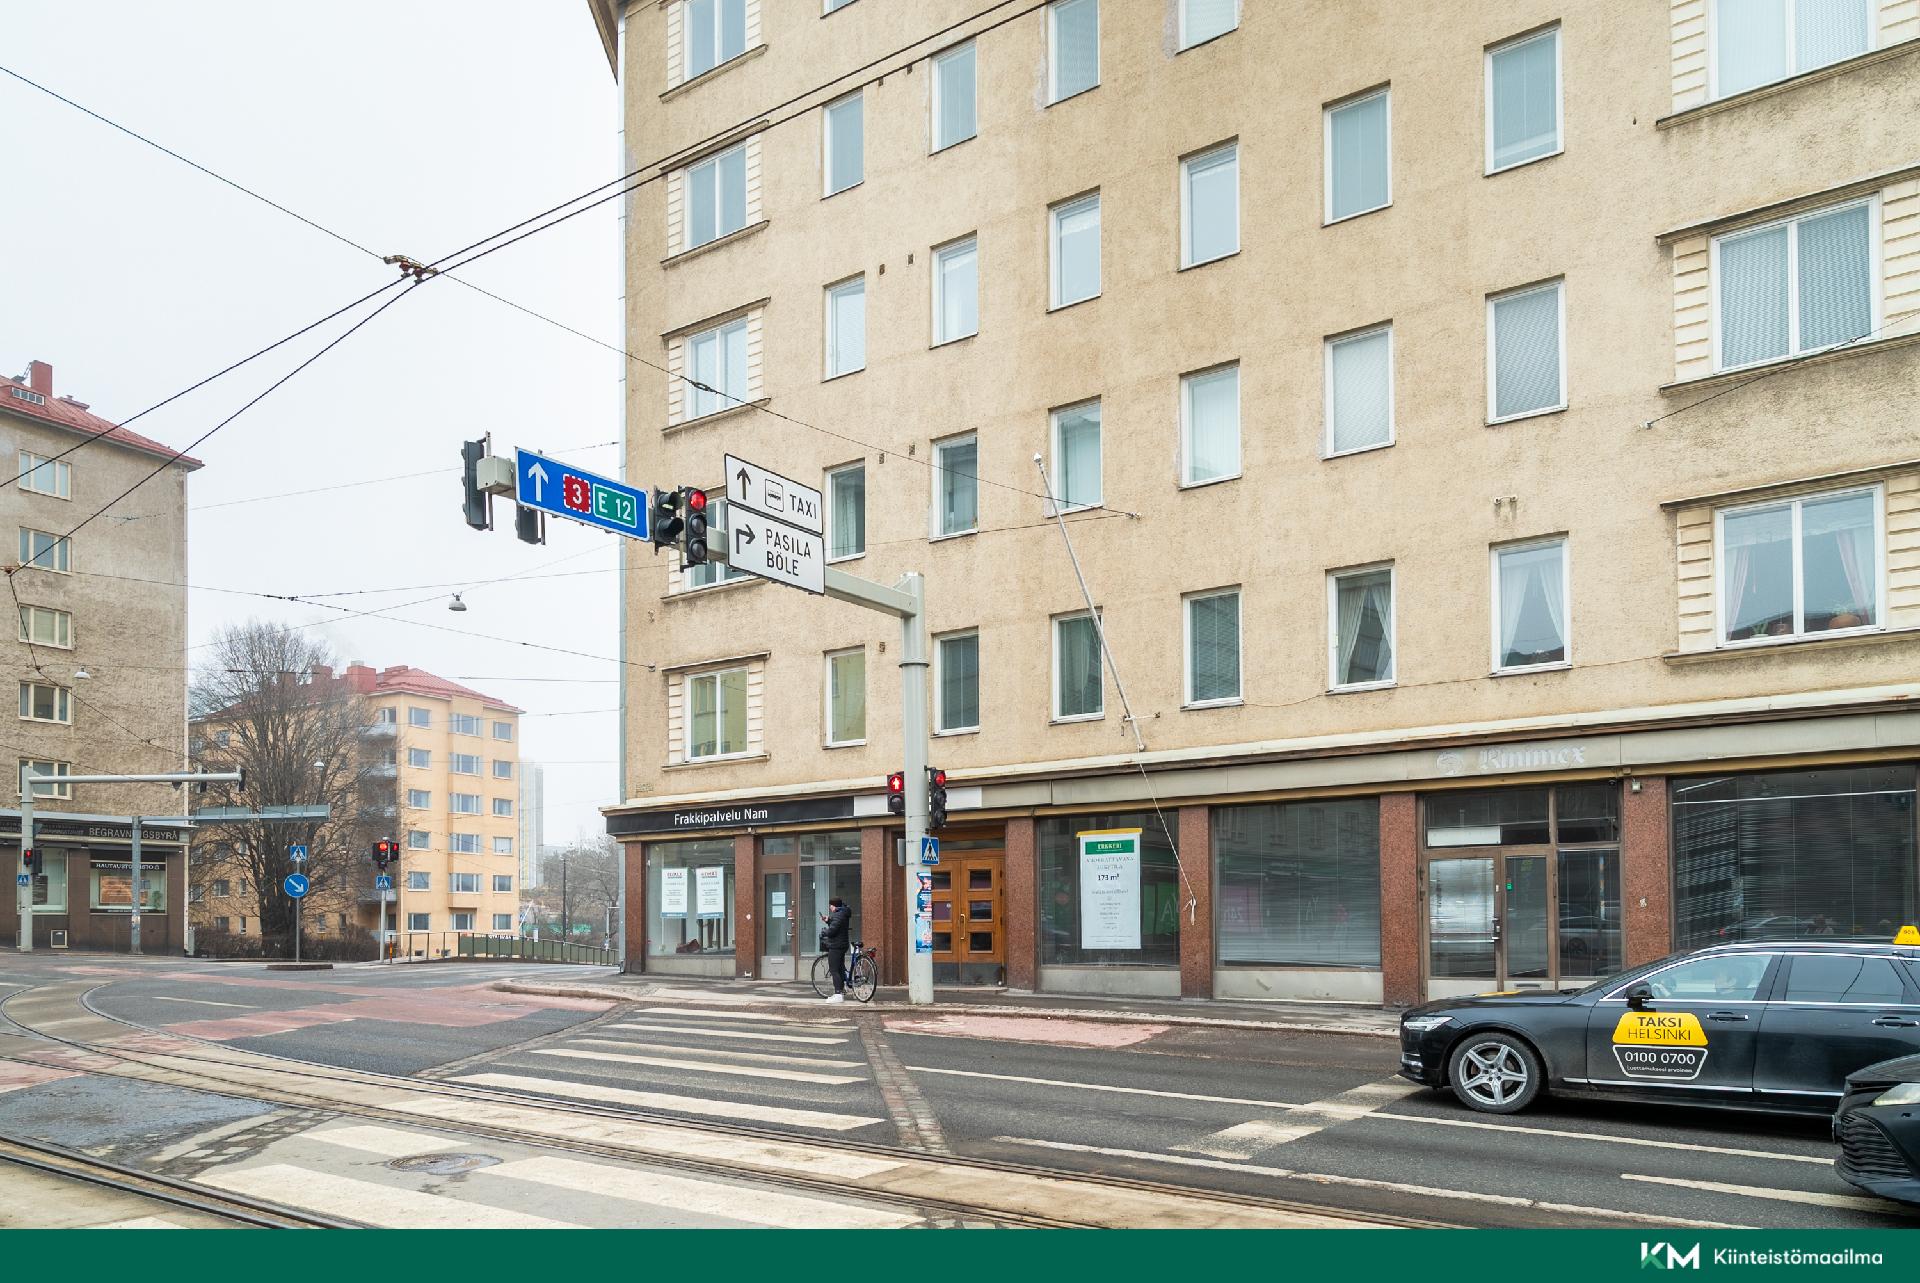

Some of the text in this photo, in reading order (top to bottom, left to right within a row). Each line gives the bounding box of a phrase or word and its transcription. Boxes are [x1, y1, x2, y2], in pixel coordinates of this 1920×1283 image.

[572, 484, 631, 520] 3 E 12
[789, 493, 817, 519] TAXI
[766, 528, 811, 559] PASILA
[766, 550, 799, 576] BÖLE
[674, 808, 768, 826] Frakkipalvelu Nam
[89, 827, 178, 840] BEGRAVNGSBYRÅ
[1637, 1016, 1682, 1028] TAKSI
[1628, 1028, 1691, 1041] HELSINKI
[1624, 1051, 1696, 1065] 0100 0700
